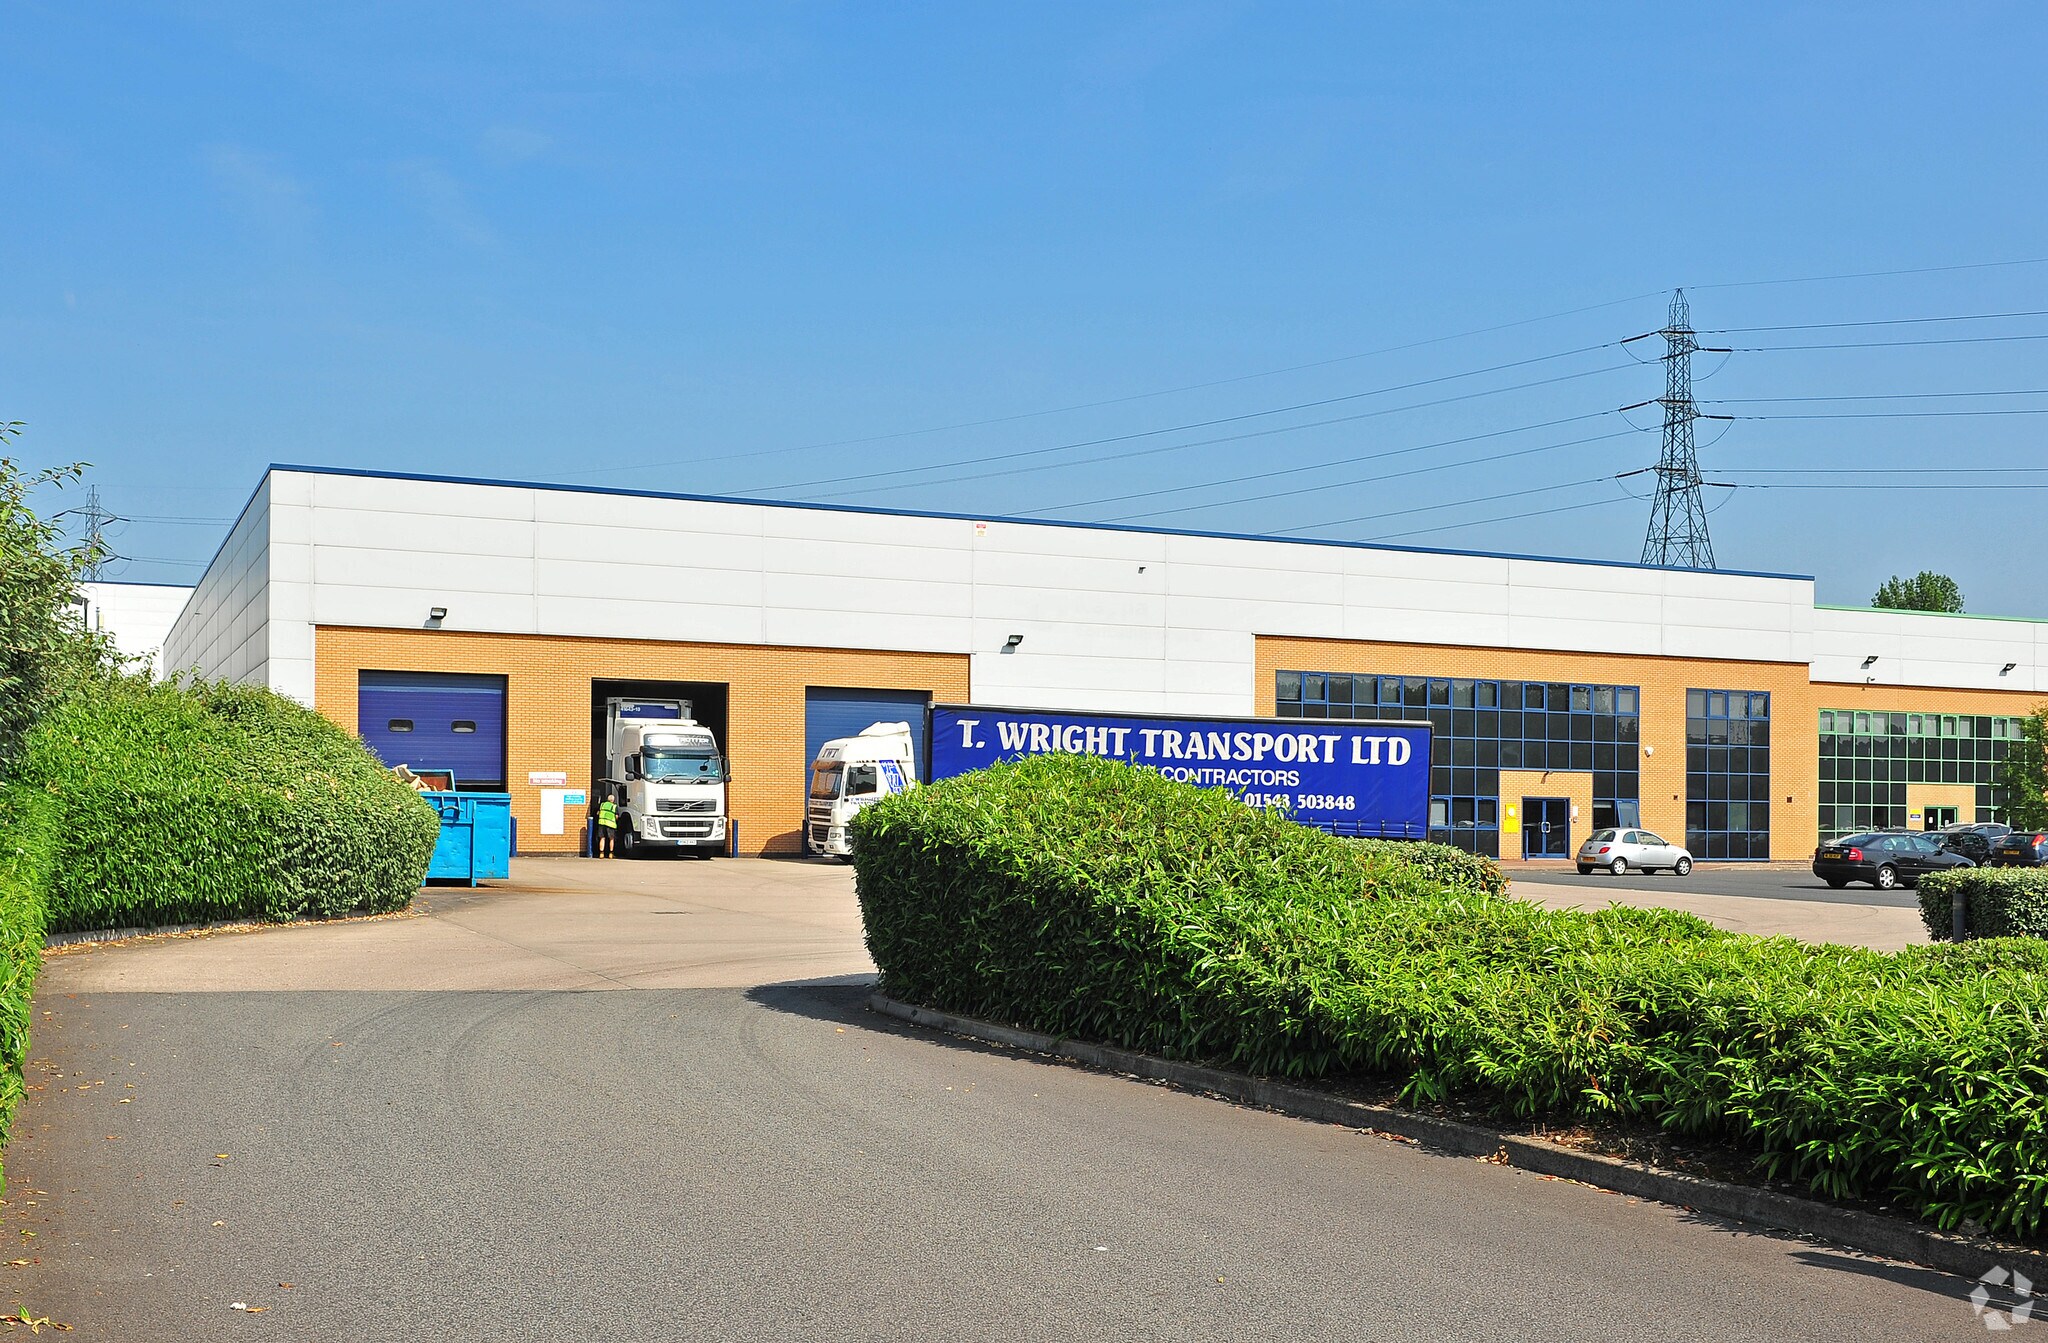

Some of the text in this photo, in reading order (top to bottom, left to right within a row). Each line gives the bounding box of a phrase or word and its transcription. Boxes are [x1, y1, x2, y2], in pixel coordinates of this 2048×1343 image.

[957, 719, 1412, 766] T. WRIGHT TRANSPORT LTD
[1160, 766, 1301, 787] CONTRACTORS
[1243, 792, 1291, 809] 01543
[1297, 794, 1356, 810] 503848
